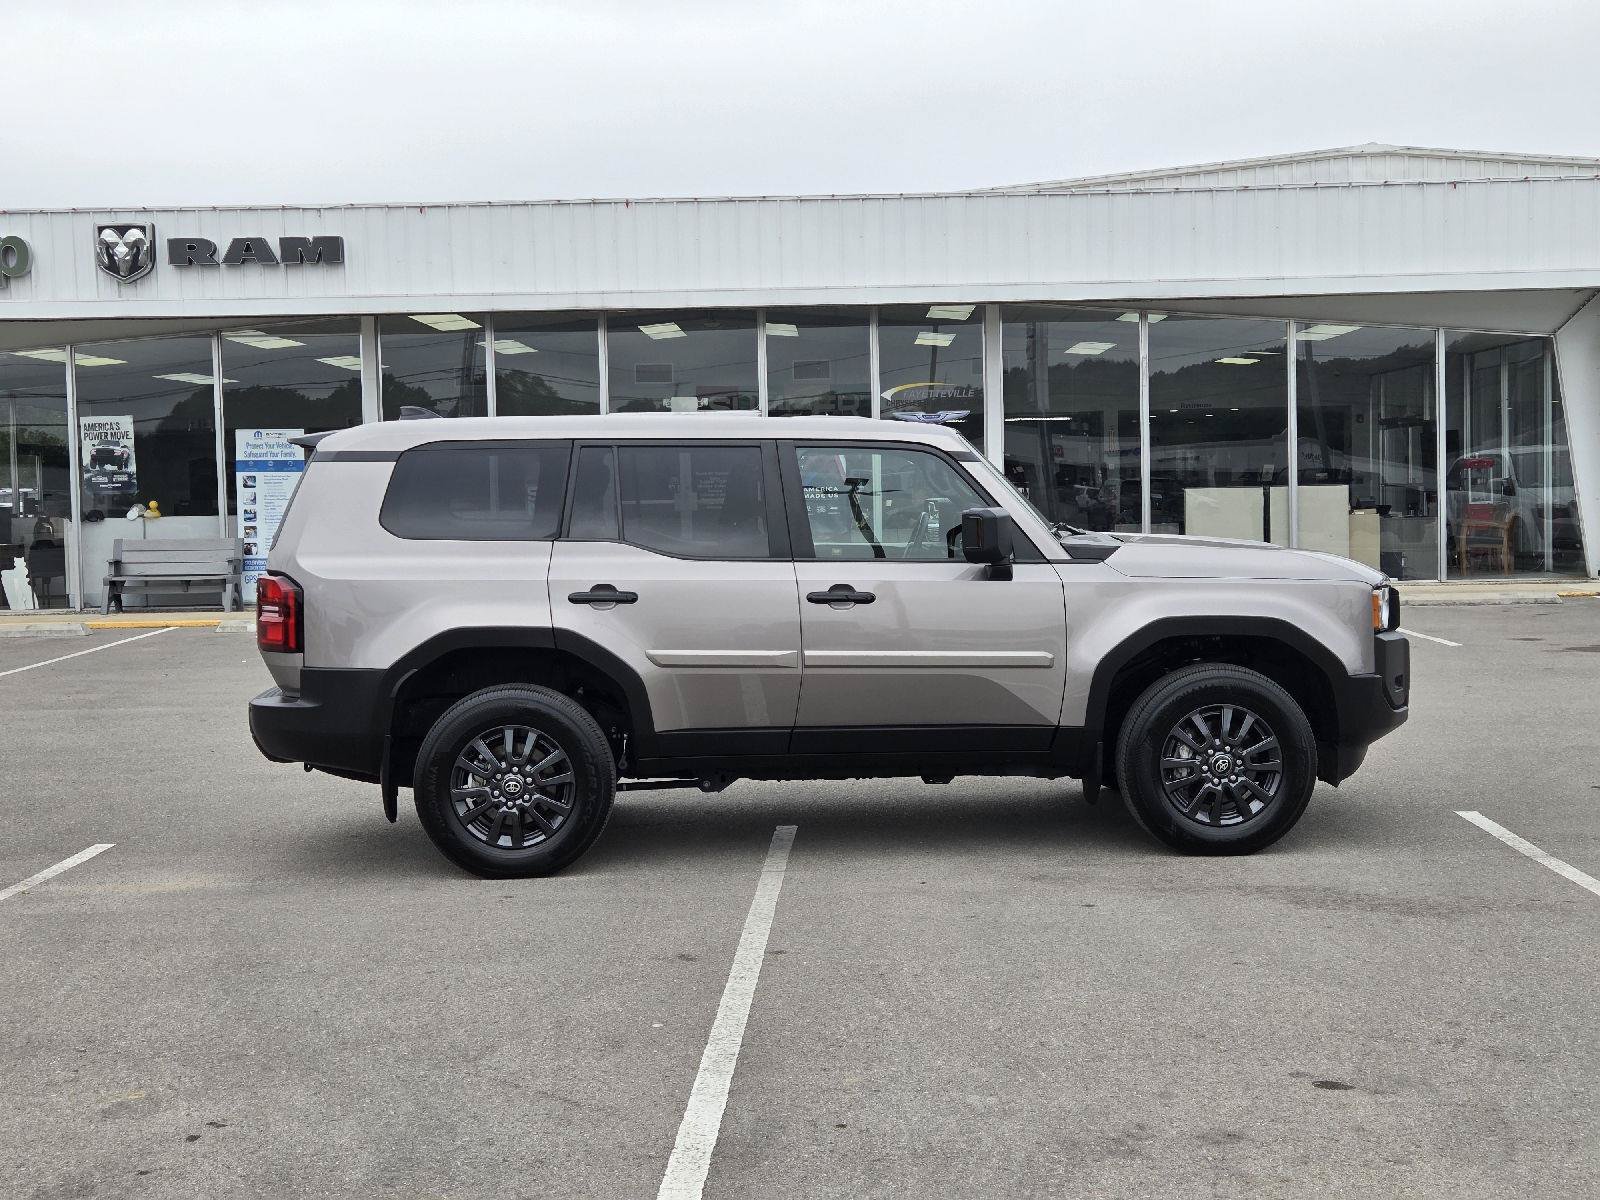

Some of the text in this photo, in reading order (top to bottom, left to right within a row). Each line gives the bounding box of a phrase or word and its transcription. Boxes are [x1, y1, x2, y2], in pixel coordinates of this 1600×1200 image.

[167, 236, 344, 265] RAM
[83, 422, 121, 432] AMERICA'S
[83, 430, 133, 441] POWER MOVE.
[264, 442, 275, 450] Your
[243, 450, 269, 459] Safeguard
[269, 450, 280, 458] Your
